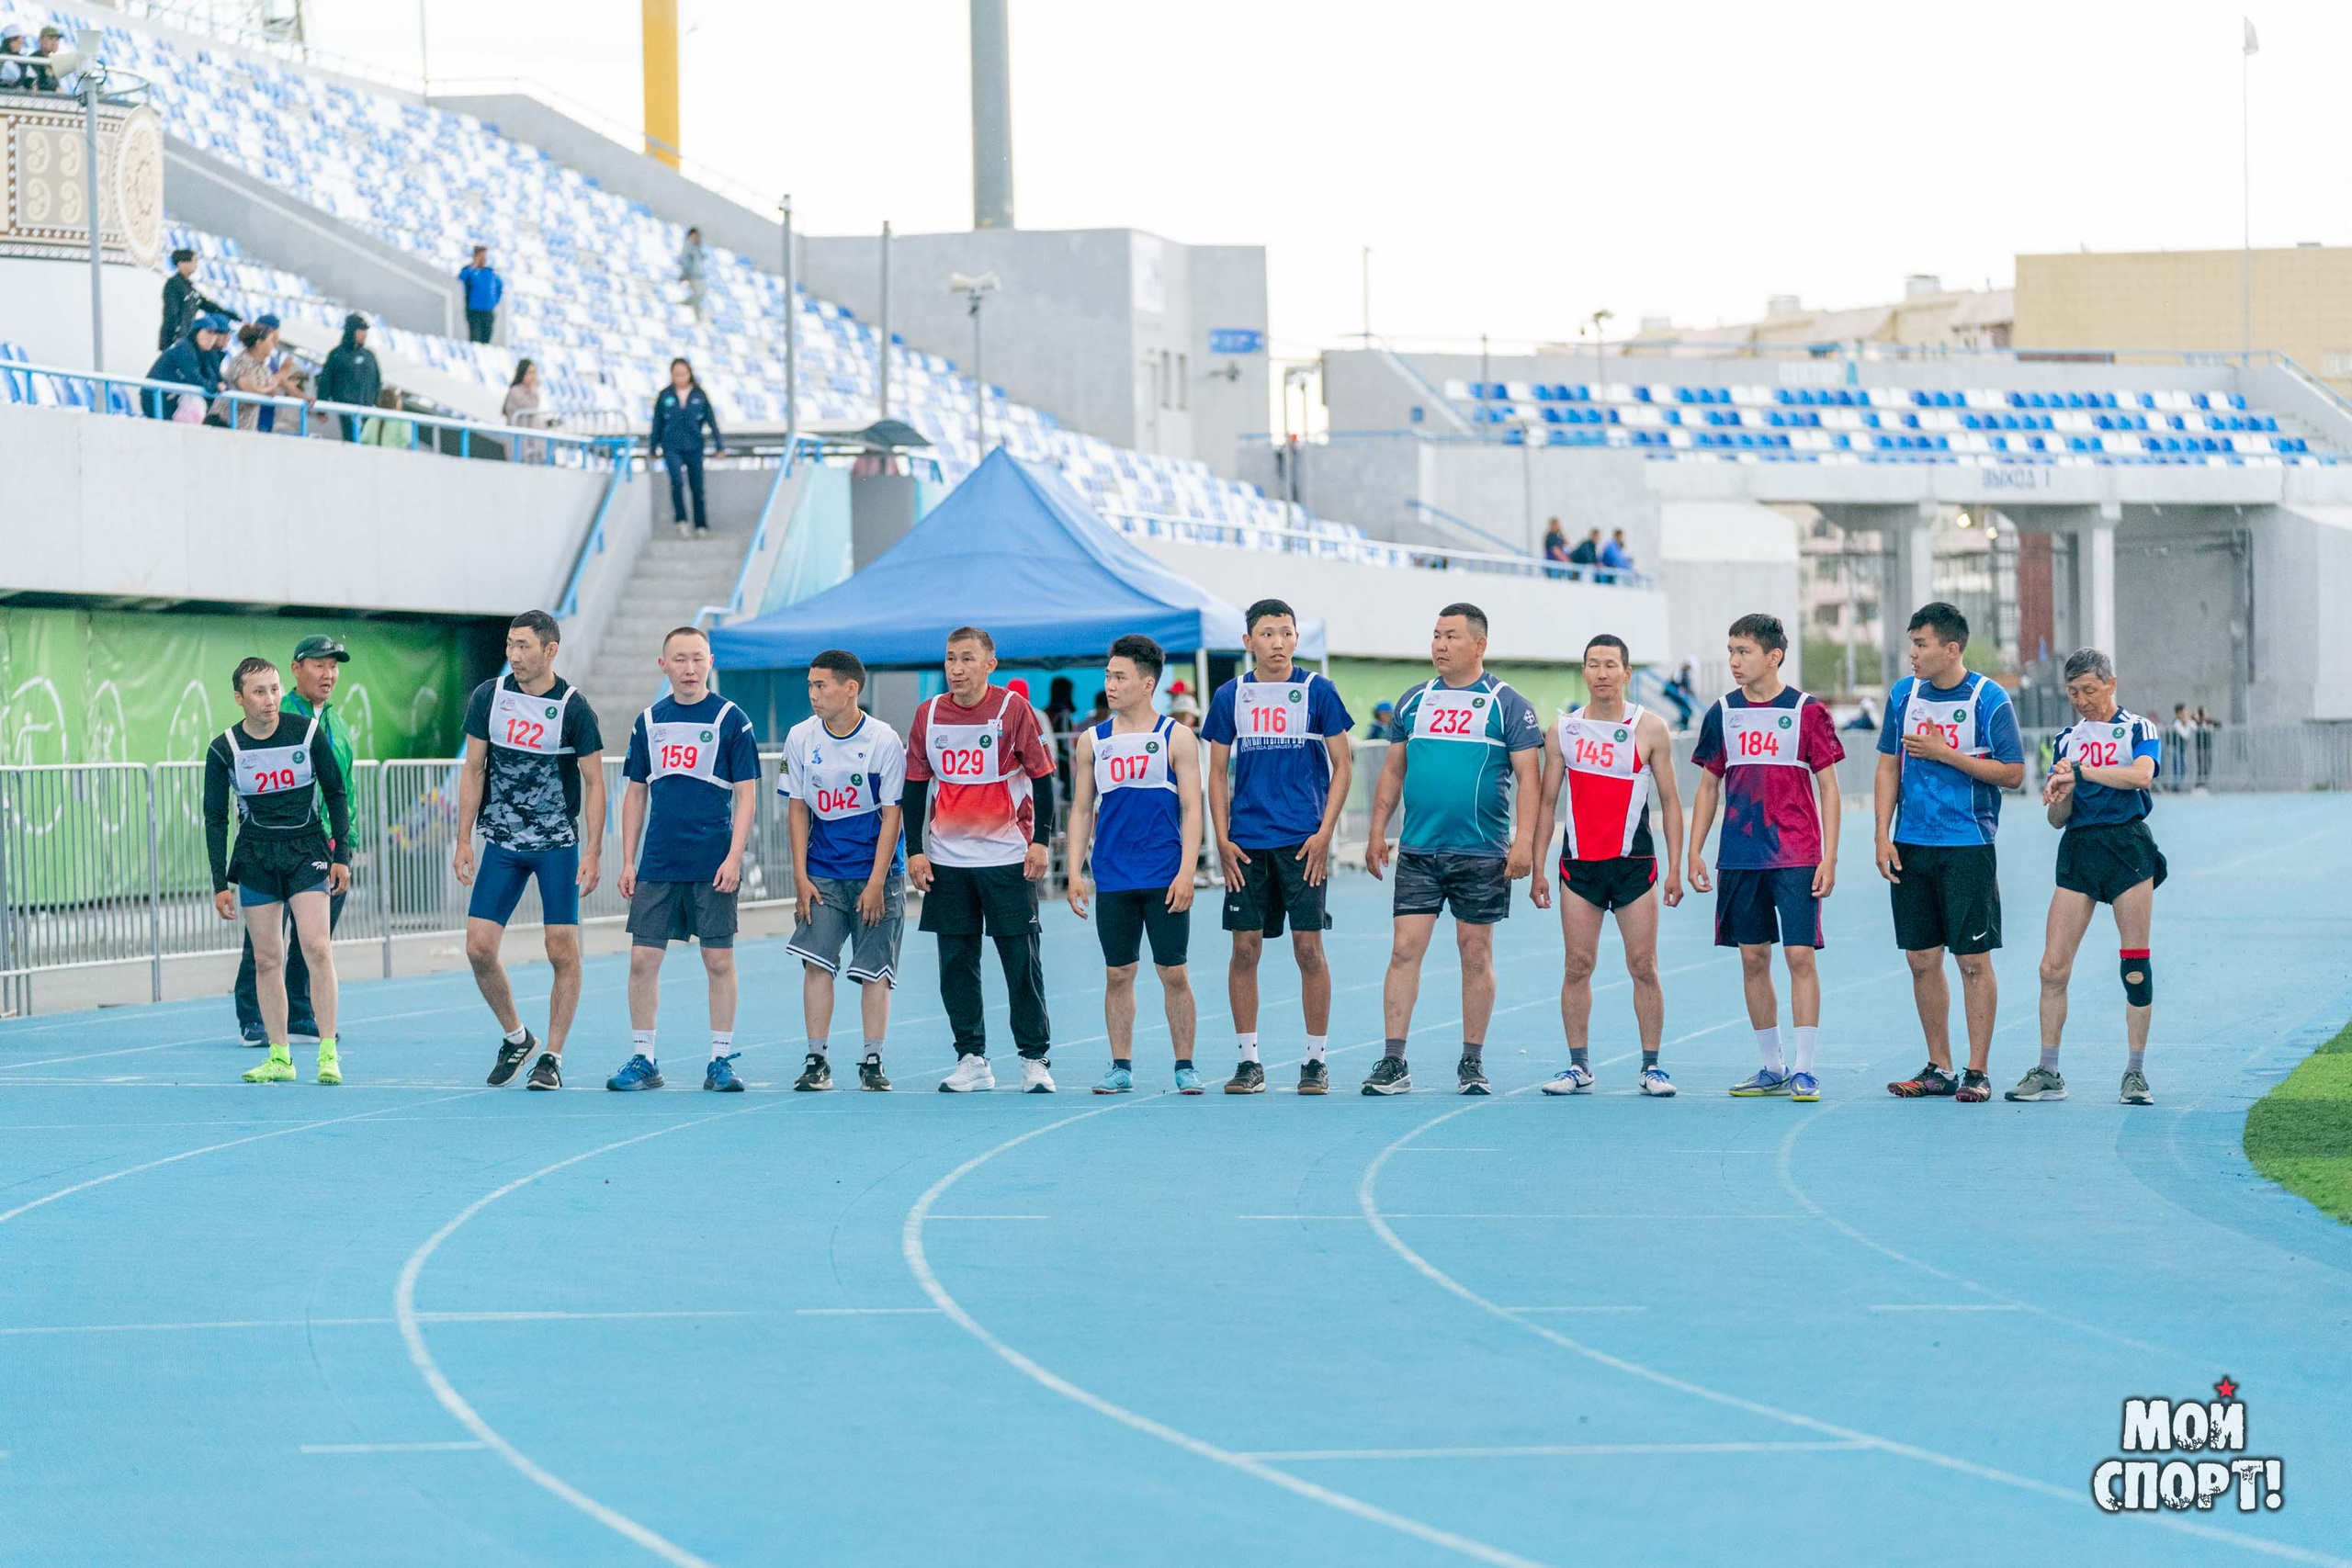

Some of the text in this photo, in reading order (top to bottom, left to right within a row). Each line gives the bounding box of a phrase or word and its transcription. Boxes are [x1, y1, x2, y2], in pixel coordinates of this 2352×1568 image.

[1251, 706, 1286, 733] 116
[1430, 709, 1473, 734] 232
[507, 718, 544, 749] 122
[1738, 731, 1780, 757] 184
[661, 745, 698, 769] 159
[942, 749, 984, 775] 029
[1575, 738, 1614, 768] 145
[2079, 741, 2119, 768] 202
[254, 768, 295, 793] 219
[1110, 755, 1149, 783] 017
[818, 785, 861, 813] 042
